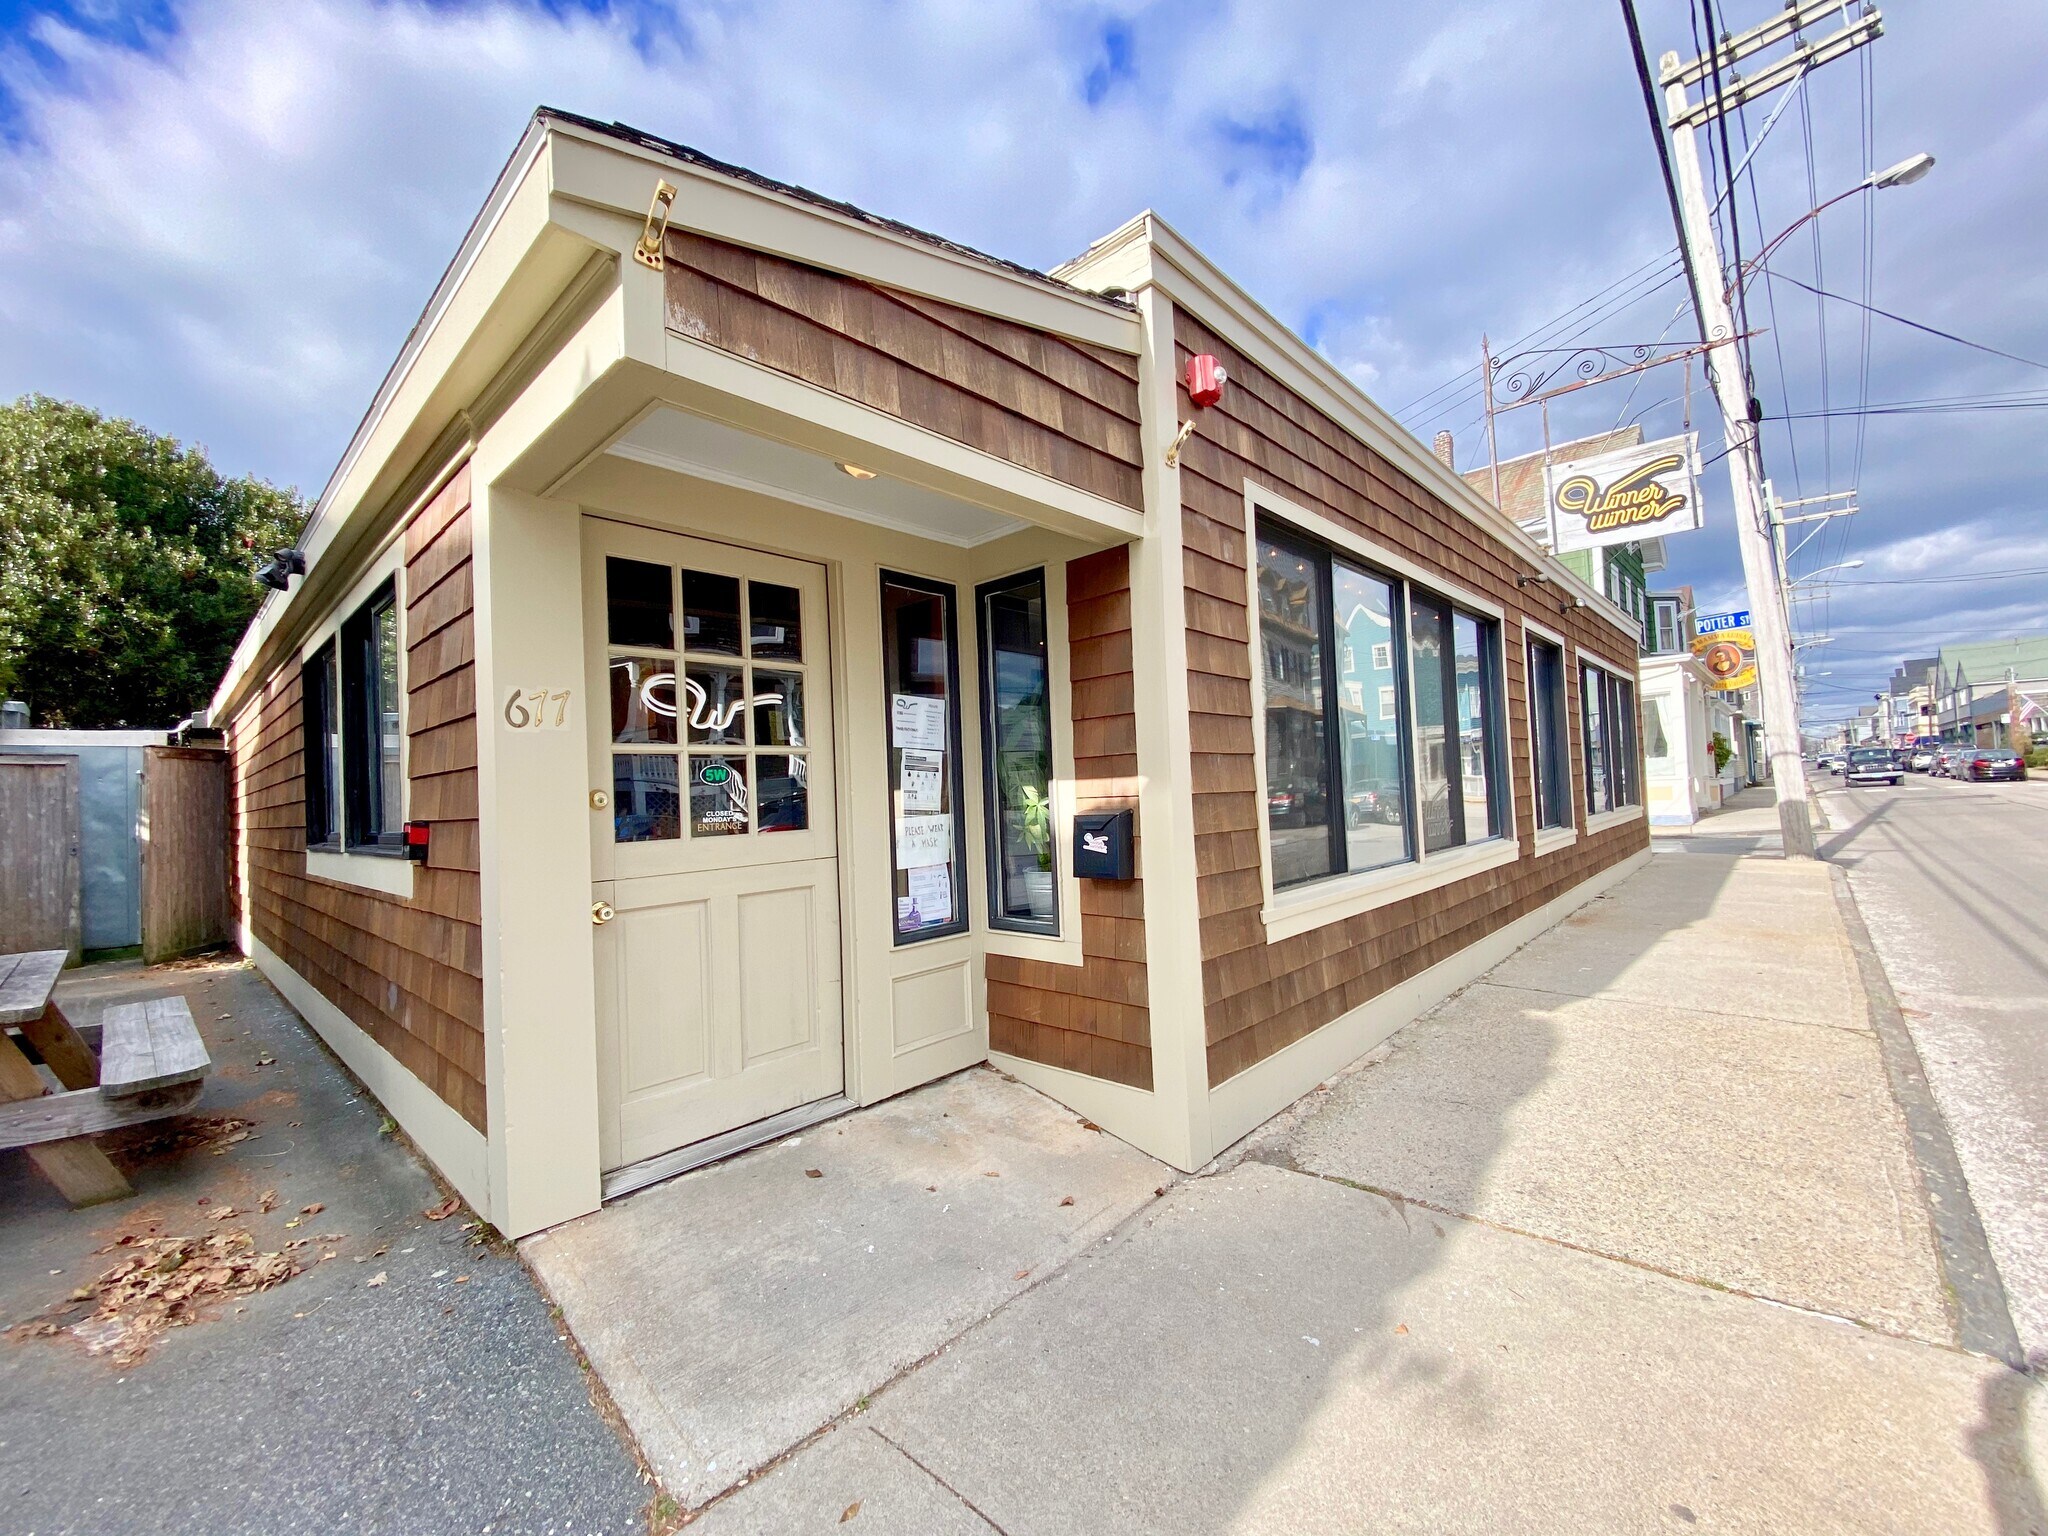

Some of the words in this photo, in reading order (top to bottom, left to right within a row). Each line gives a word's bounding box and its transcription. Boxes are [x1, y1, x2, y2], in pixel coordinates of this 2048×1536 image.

[1558, 455, 1686, 515] Winner
[1697, 615, 1735, 633] POTTER
[1740, 614, 1750, 625] ST
[504, 688, 571, 728] 677
[705, 769, 727, 781] 5W
[697, 822, 743, 832] ENTRANCE
[905, 826, 924, 836] PLEASE
[928, 823, 944, 832] WEAR
